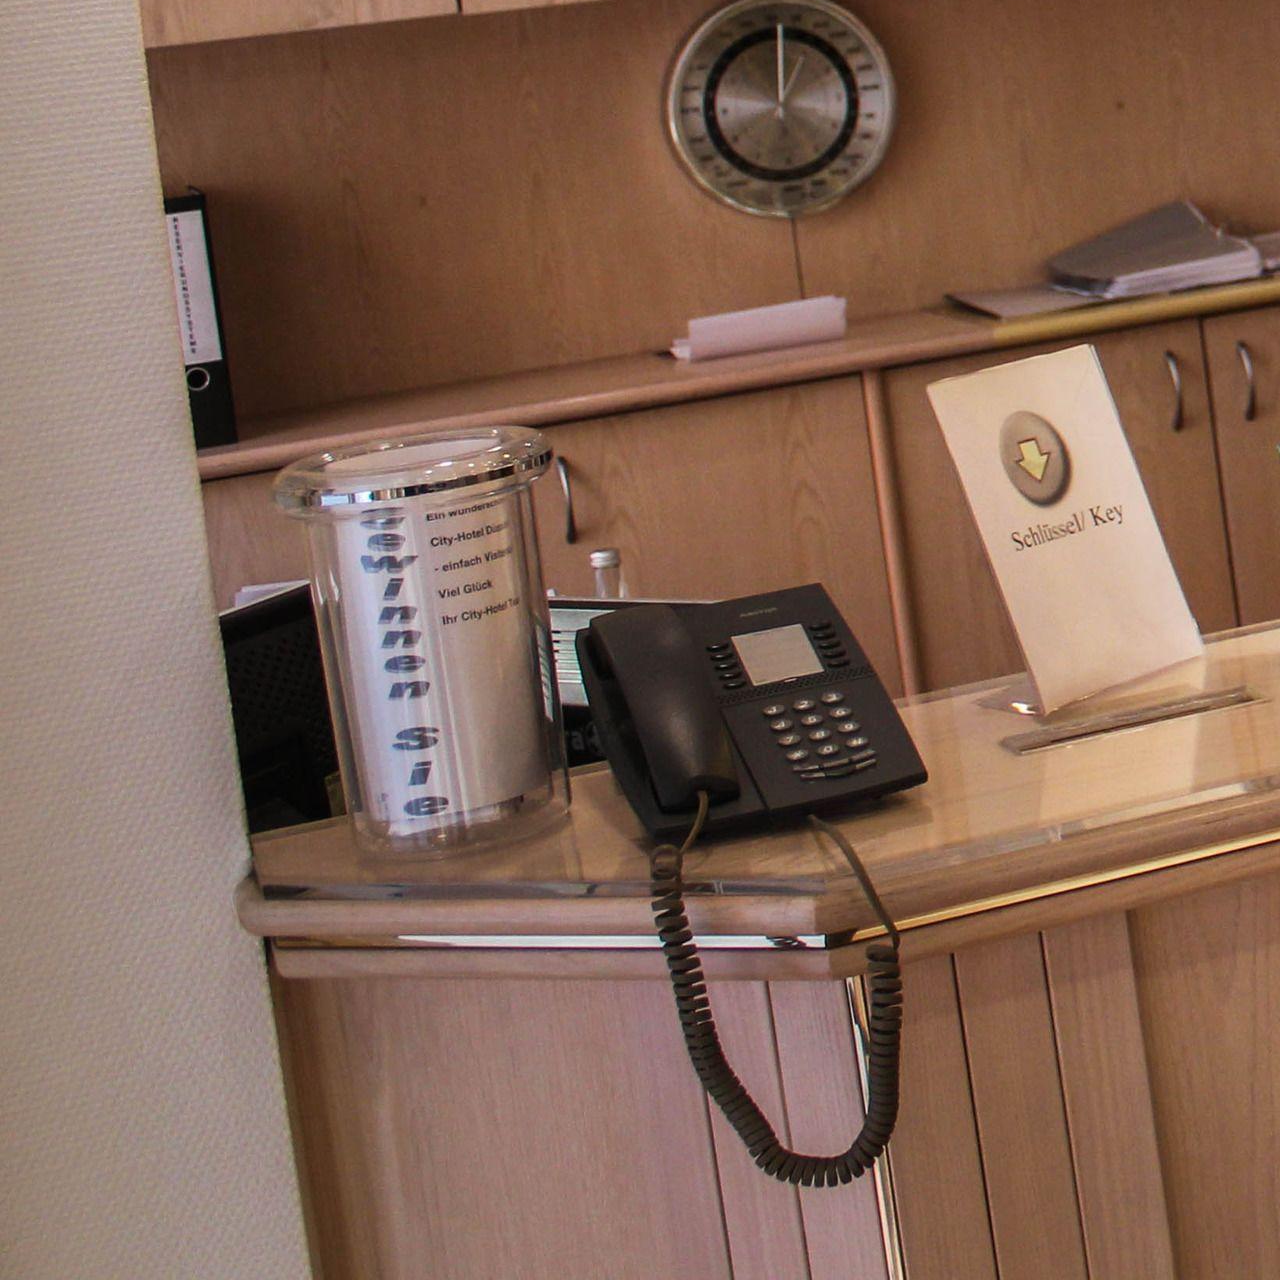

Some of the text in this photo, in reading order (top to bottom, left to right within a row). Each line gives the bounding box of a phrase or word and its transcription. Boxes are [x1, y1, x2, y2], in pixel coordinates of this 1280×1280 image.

[1089, 505, 1124, 525] Key
[430, 528, 485, 547] City-Hotel
[442, 556, 482, 572] einfach
[439, 580, 492, 599] Viel Glück
[442, 614, 458, 625] Ihr
[461, 602, 508, 622] City-Hotel
[392, 726, 449, 816] Sie
